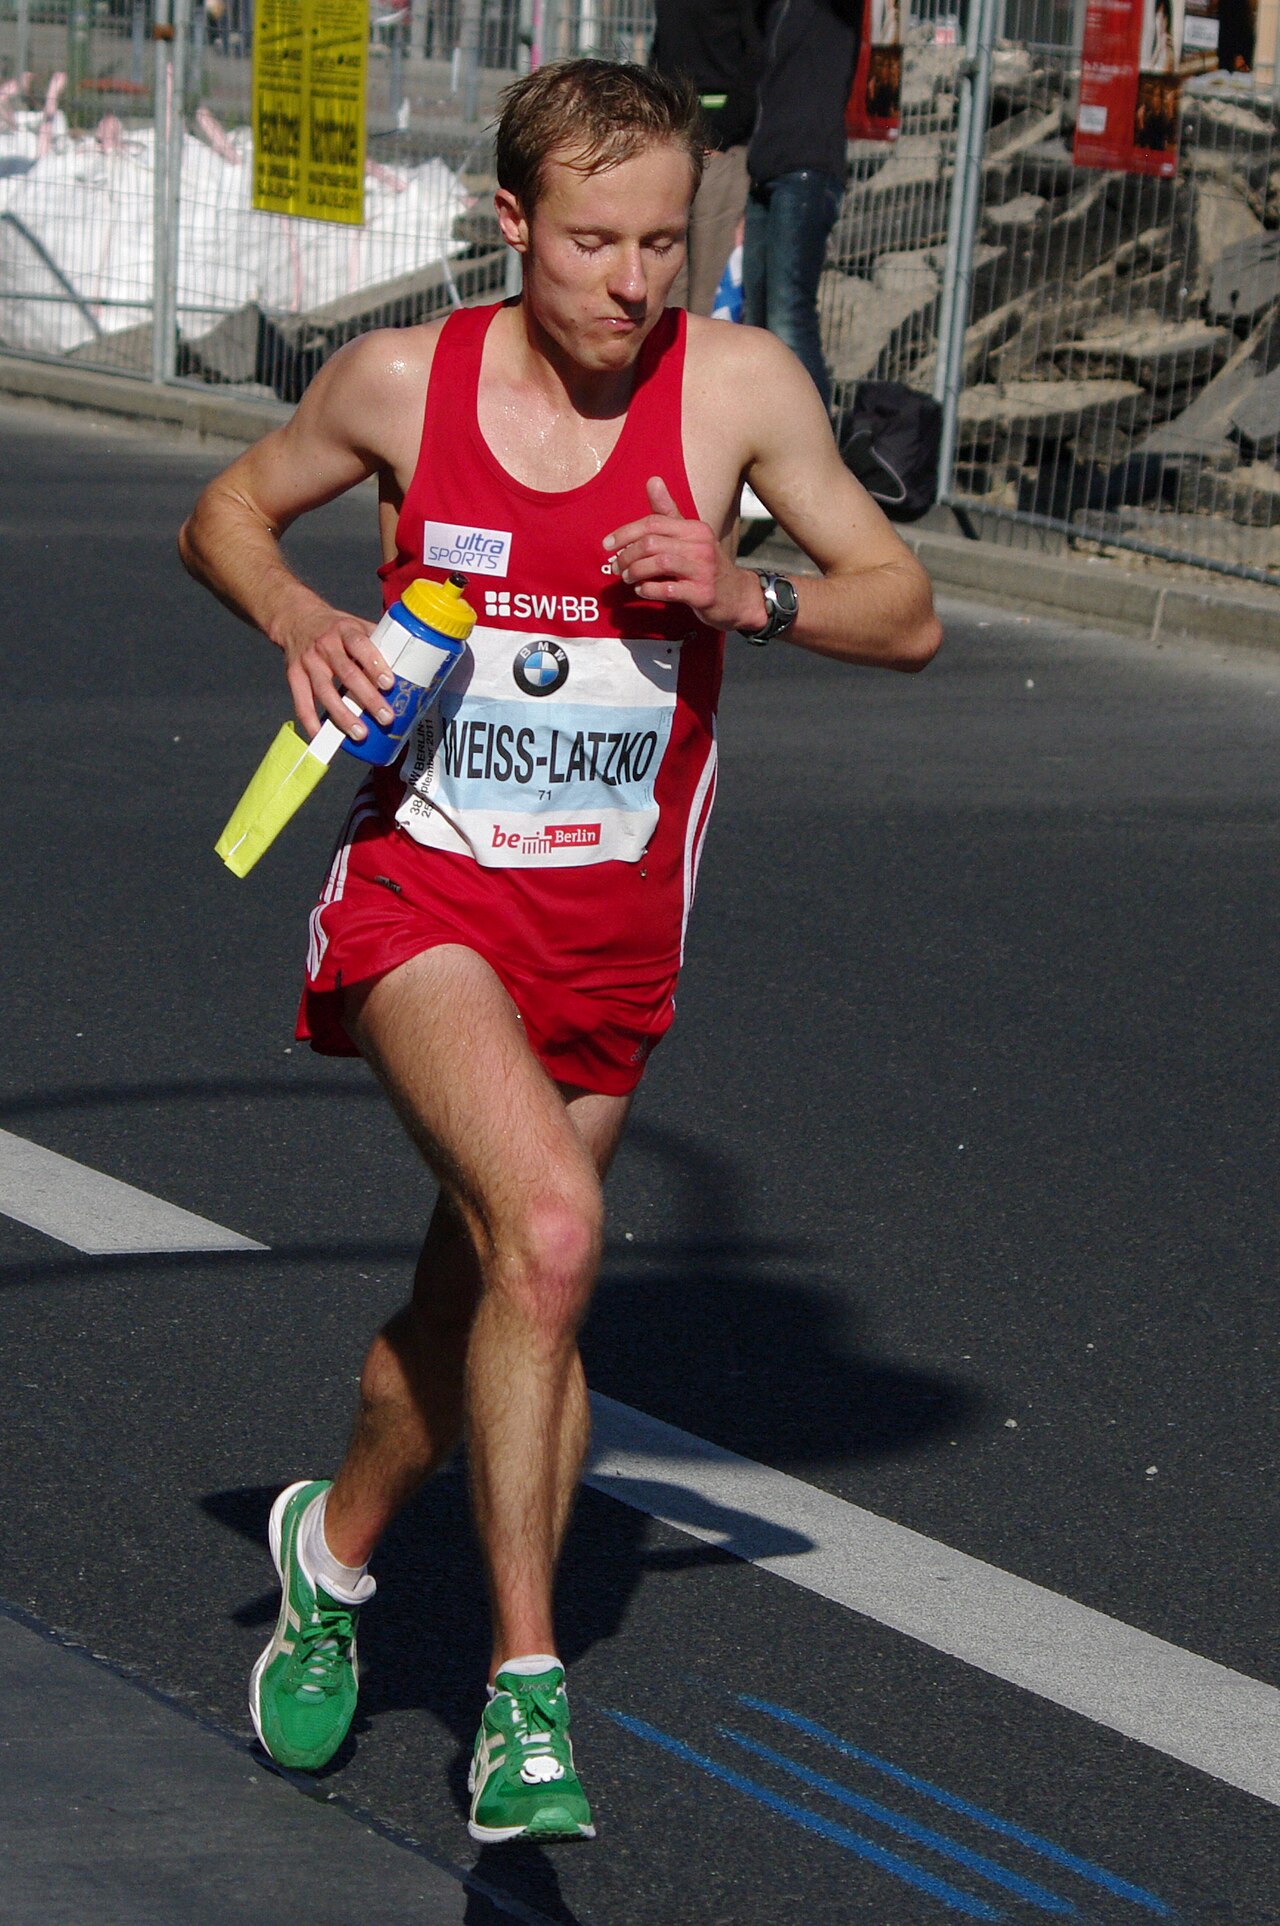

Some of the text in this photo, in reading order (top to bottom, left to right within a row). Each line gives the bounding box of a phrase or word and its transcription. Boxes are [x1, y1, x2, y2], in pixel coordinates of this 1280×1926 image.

[455, 533, 504, 555] ultra
[428, 546, 499, 569] SPORTS
[519, 641, 566, 662] BMW
[425, 719, 434, 746] 2011
[442, 717, 658, 786] WEISS-LATZKO
[420, 747, 434, 793] ptember
[538, 790, 552, 801] 71
[491, 824, 596, 848] be Berlin
